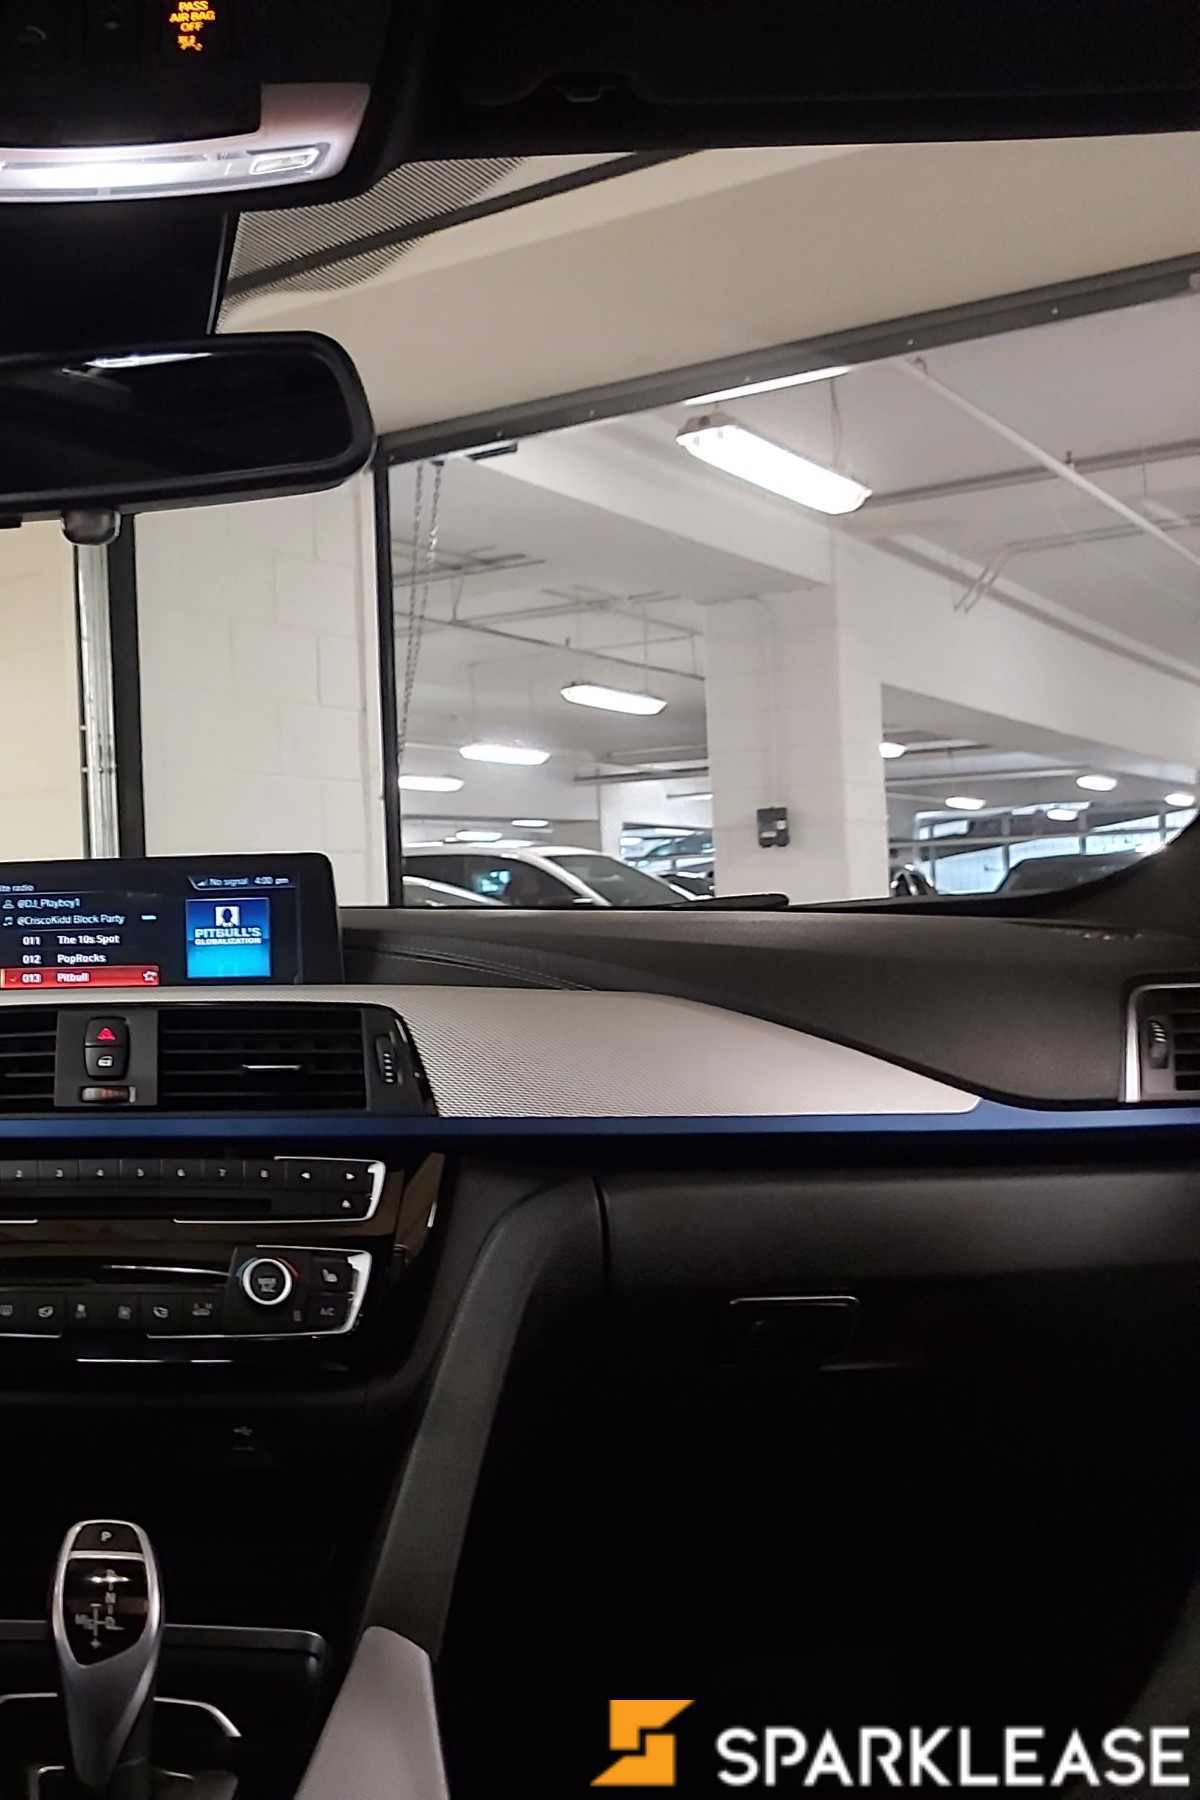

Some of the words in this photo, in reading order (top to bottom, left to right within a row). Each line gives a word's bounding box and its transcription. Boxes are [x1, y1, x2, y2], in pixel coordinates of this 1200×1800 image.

[178, 1, 209, 11] PASS
[169, 13, 190, 23] AIR
[180, 22, 204, 32] OFF
[12, 883, 35, 892] radio
[223, 876, 248, 888] signal
[73, 914, 99, 924] Block
[100, 913, 126, 925] Party
[194, 927, 262, 938] PITBULL'S
[22, 935, 42, 946] 011
[57, 934, 78, 945] The
[194, 938, 262, 946] GLOBALIZATION
[22, 954, 42, 965] 012
[56, 953, 108, 965] PopRocks
[21, 972, 43, 984] 013
[56, 971, 90, 983] Pitbull
[101, 1531, 112, 1542] P
